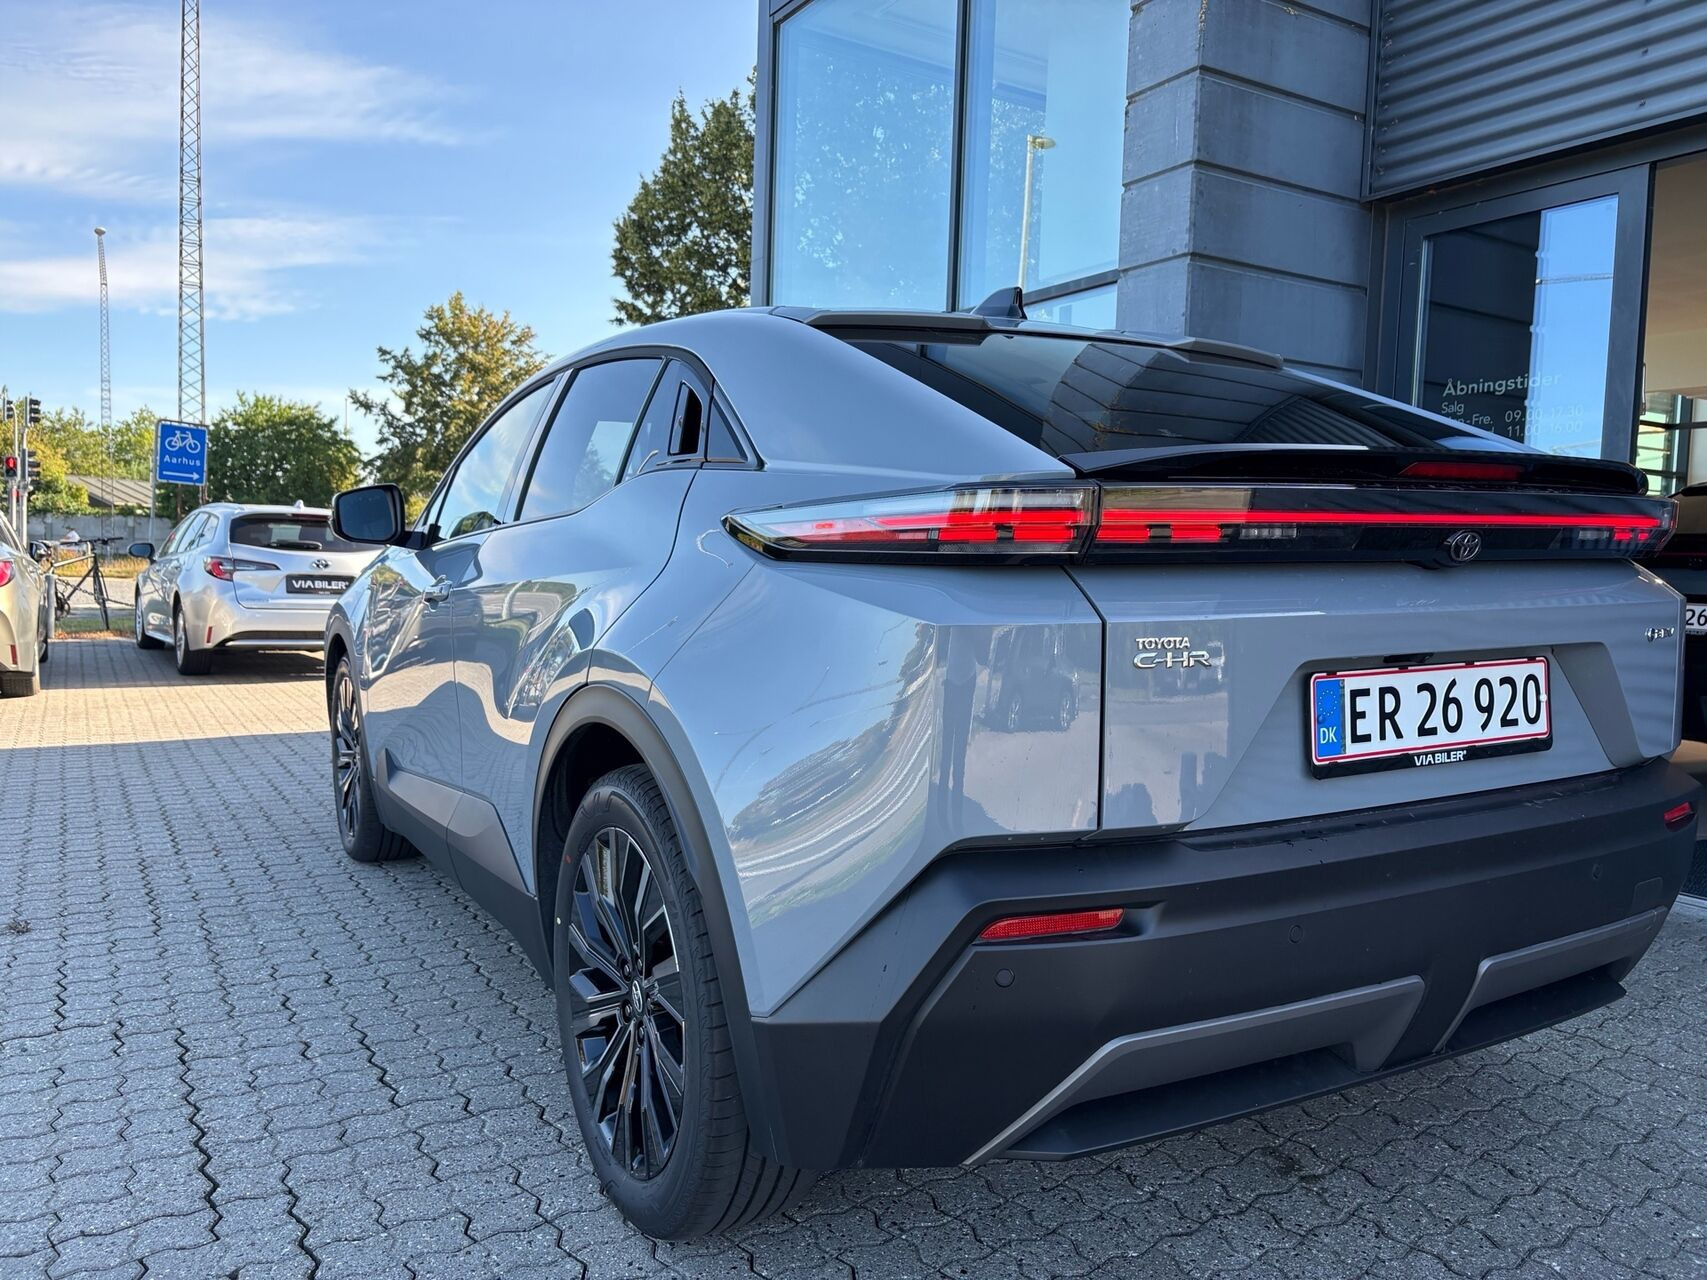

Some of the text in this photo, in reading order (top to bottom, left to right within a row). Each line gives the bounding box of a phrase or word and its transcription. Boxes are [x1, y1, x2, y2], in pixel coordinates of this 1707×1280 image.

[1442, 372, 1562, 397] Åbningstider
[1441, 401, 1465, 415] Salg
[163, 454, 201, 467] Aarhus
[1135, 637, 1190, 650] TOYOTA
[1133, 650, 1212, 669] C-HR
[1349, 673, 1542, 744] ER 26 920
[1319, 726, 1338, 745] DK
